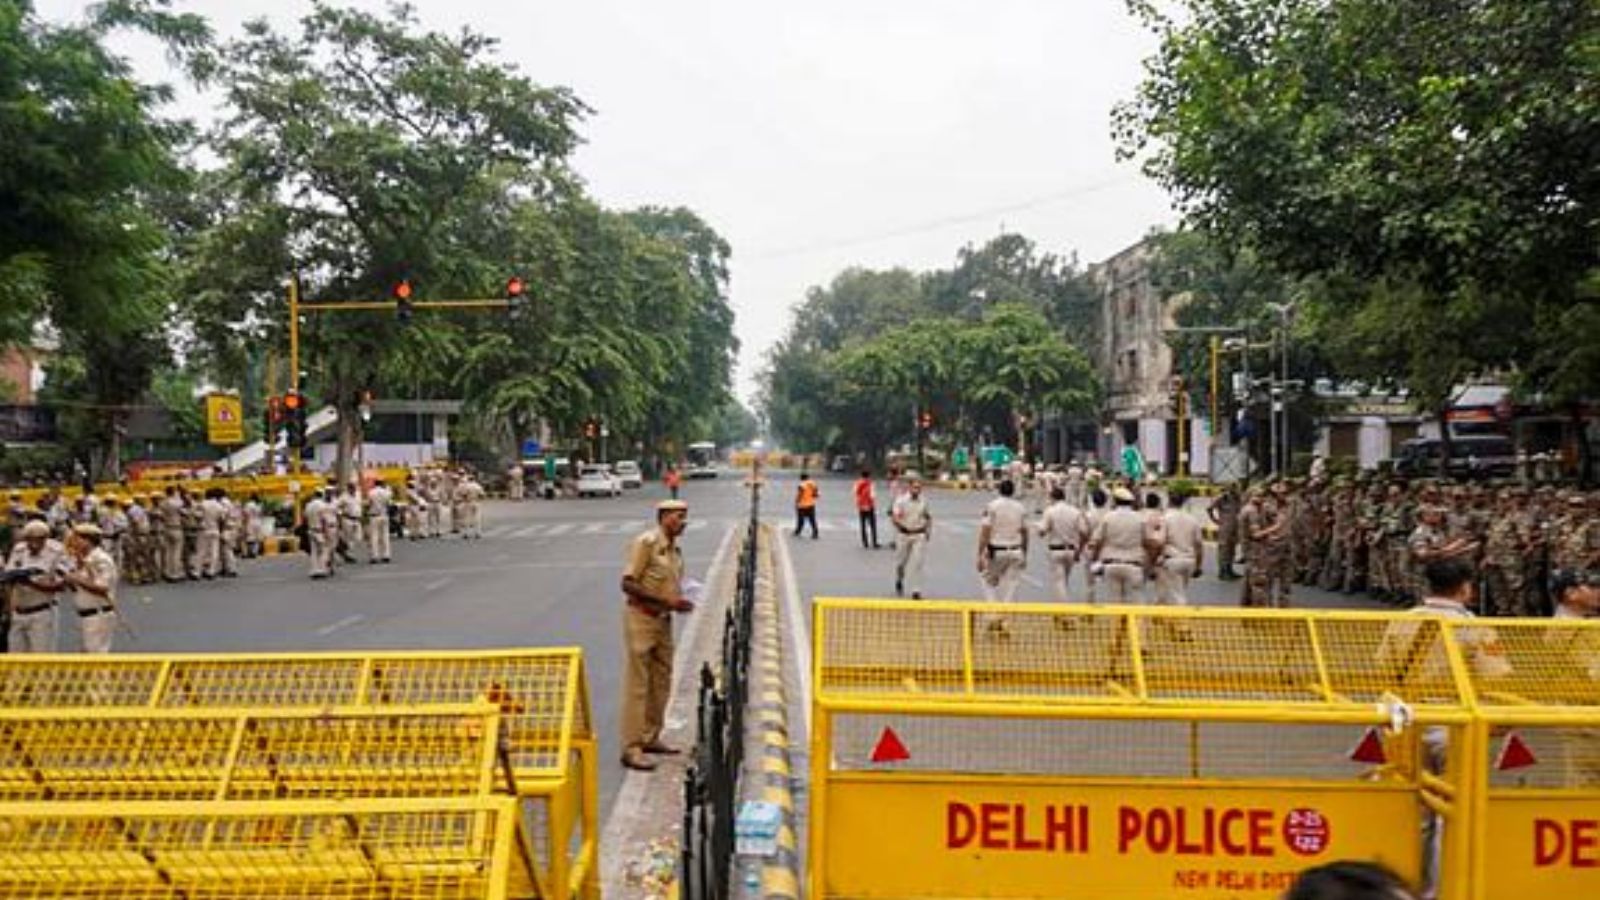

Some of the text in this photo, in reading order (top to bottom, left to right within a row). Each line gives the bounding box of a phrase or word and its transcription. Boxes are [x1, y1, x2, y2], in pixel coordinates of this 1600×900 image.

[947, 802, 1274, 857] DELHI POLICE
[1534, 819, 1600, 867] DE
